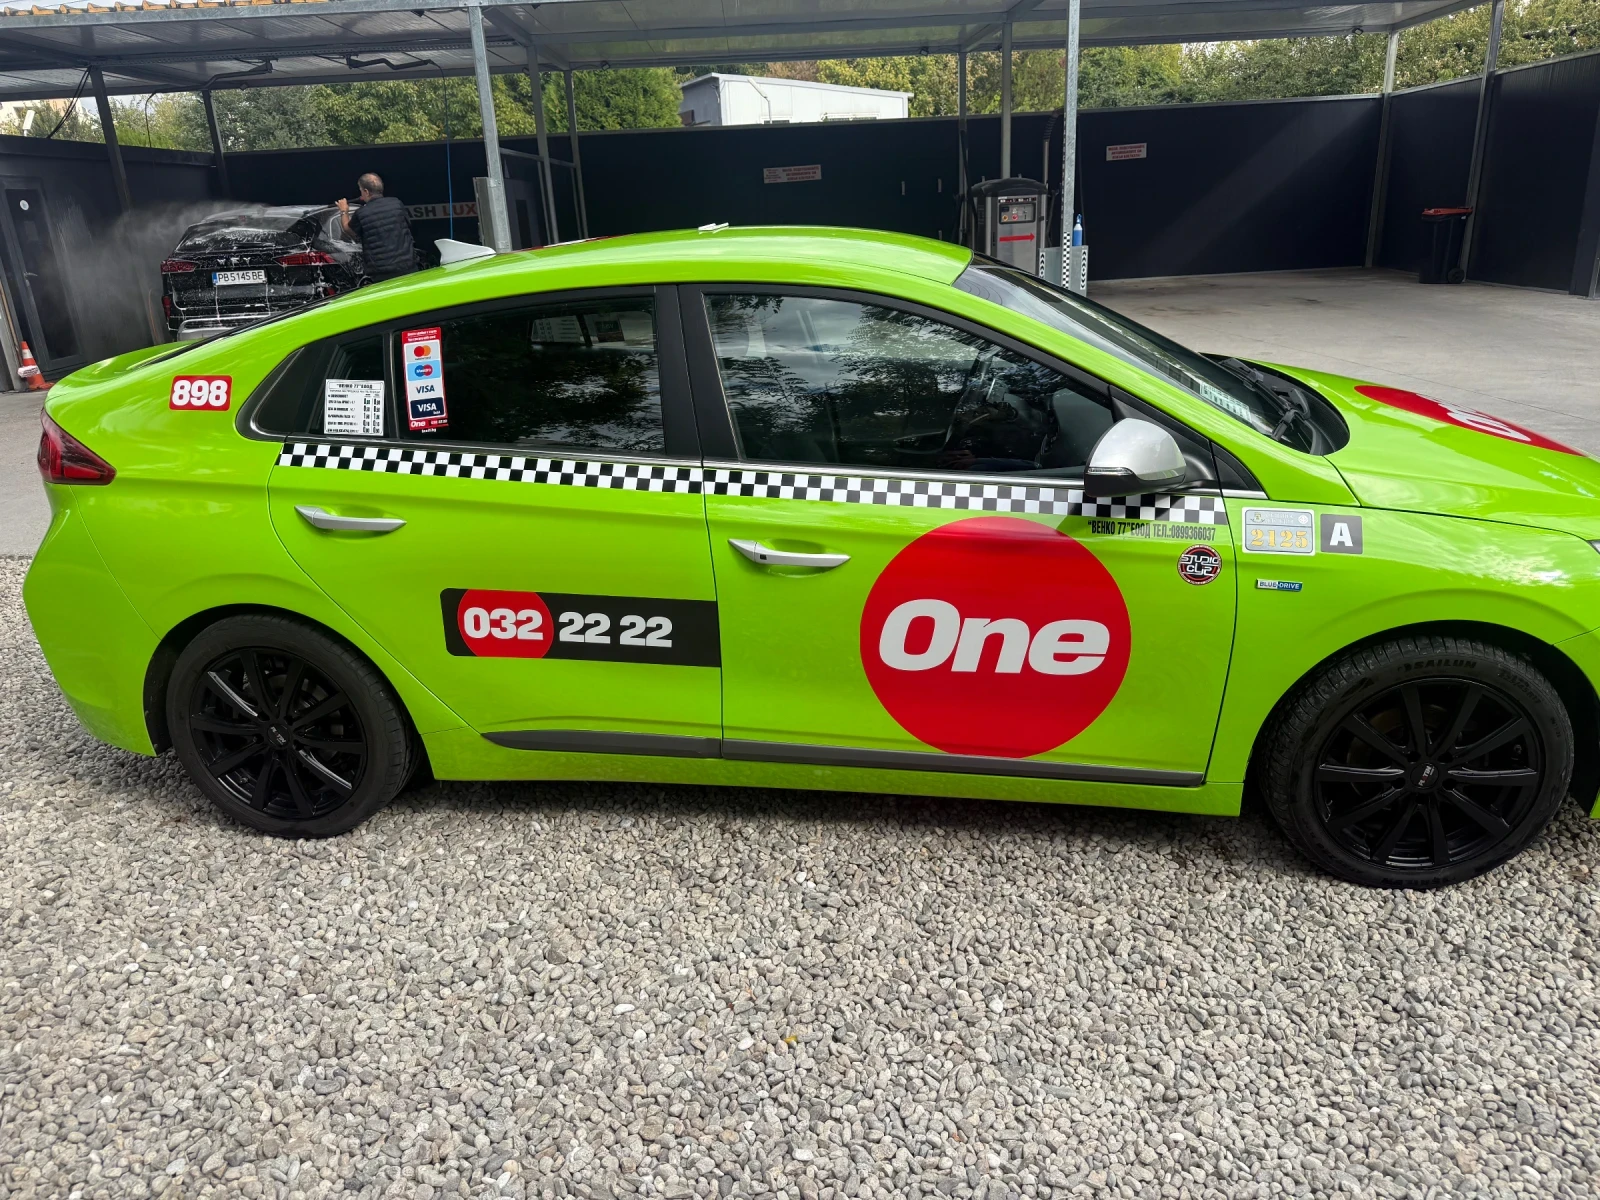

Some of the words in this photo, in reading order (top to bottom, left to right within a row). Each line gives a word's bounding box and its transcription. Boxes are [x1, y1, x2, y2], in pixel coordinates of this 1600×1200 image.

[442, 203, 478, 217] LUX
[230, 271, 251, 281] 5145
[172, 379, 228, 406] 898
[416, 385, 435, 394] VISA
[417, 403, 437, 412] VISA
[410, 420, 426, 428] One
[1088, 520, 1116, 535] "ВЕНКО
[1329, 522, 1354, 547] A
[1250, 528, 1309, 548] 2125
[1180, 554, 1220, 566] STUDIO
[463, 606, 544, 641] 032
[558, 611, 611, 644] 22
[619, 614, 673, 648] 22
[878, 598, 1110, 676] One
[1414, 659, 1477, 670] SAILUN
